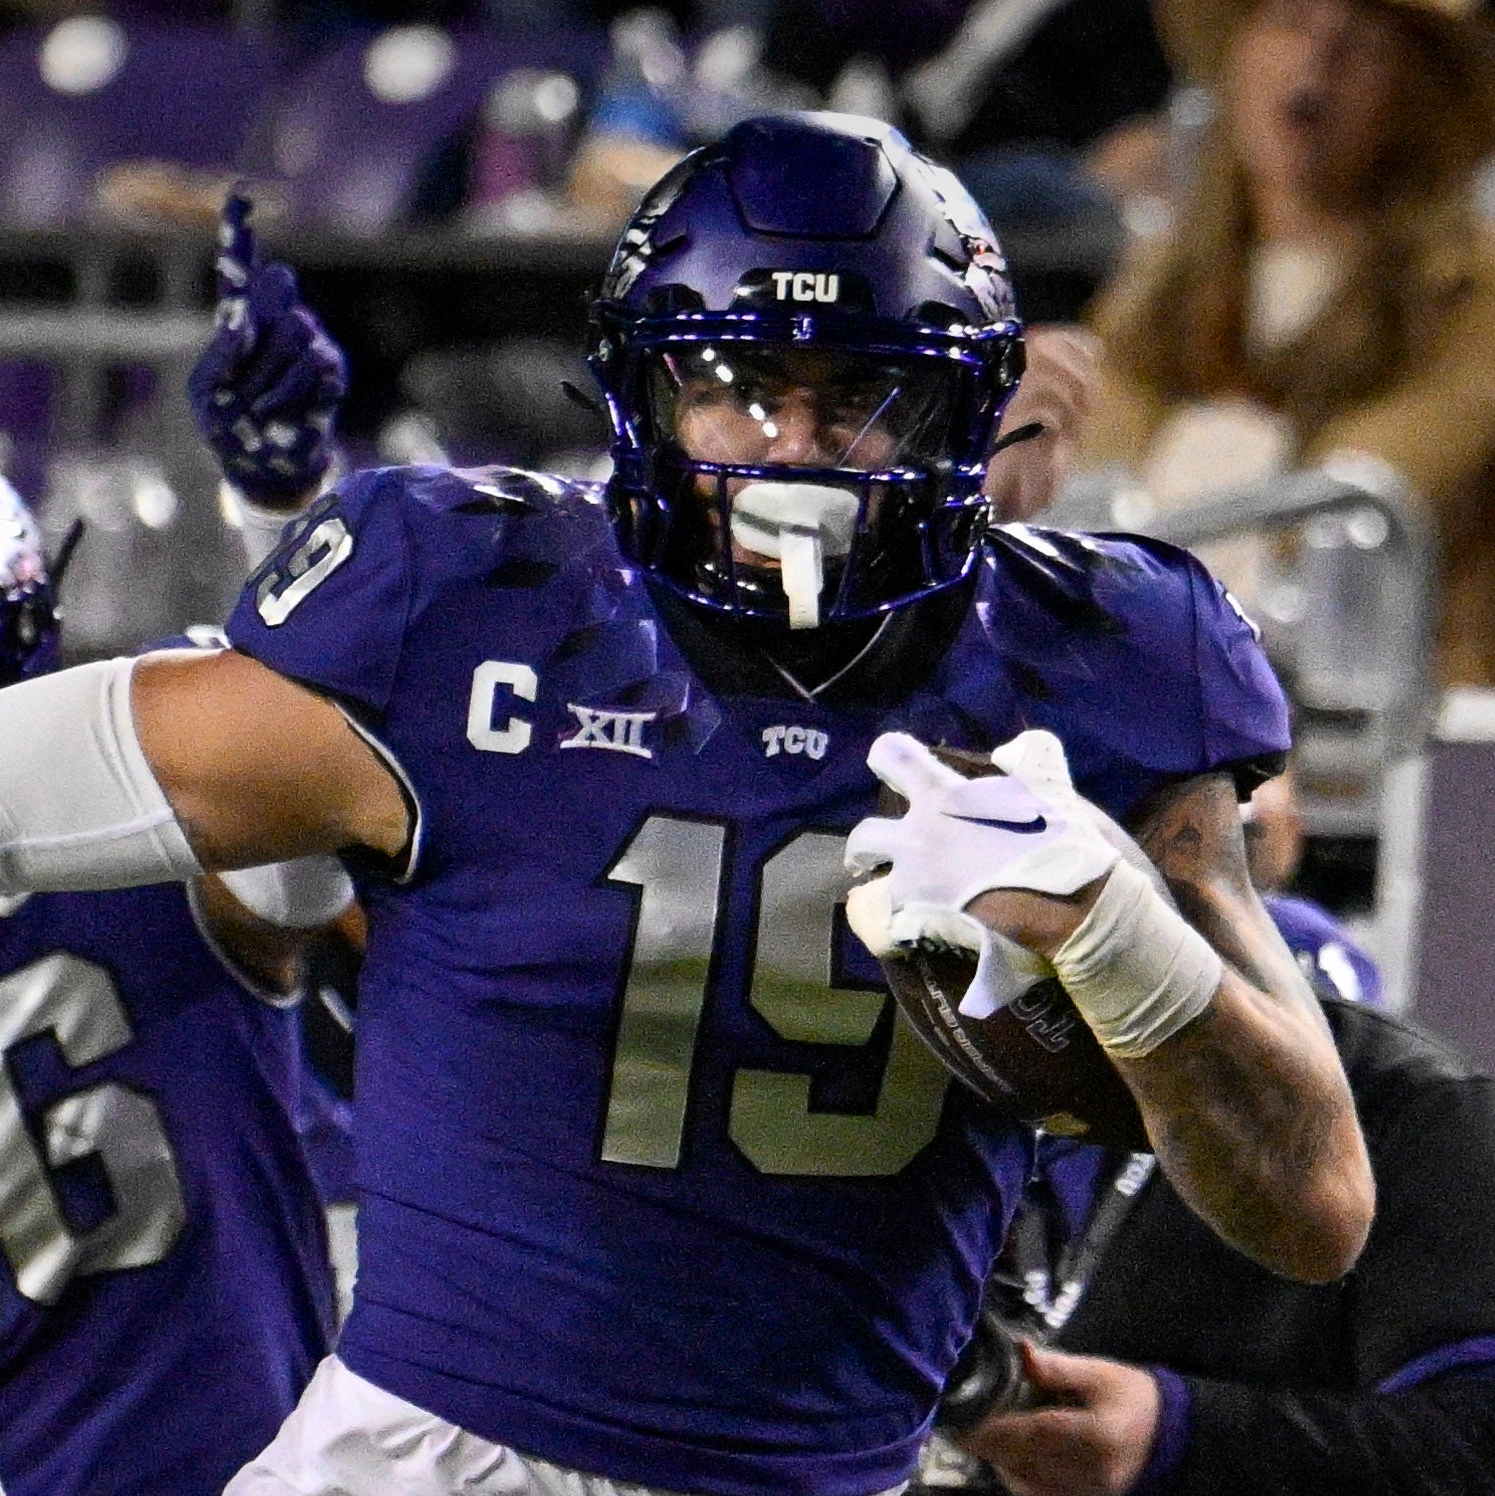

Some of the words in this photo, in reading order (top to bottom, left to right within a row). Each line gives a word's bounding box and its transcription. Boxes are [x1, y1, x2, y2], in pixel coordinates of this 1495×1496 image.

[770, 271, 840, 303] TCU
[466, 659, 538, 756] C
[559, 702, 657, 760] XII
[761, 725, 830, 761] TCU
[600, 815, 954, 1176] 19
